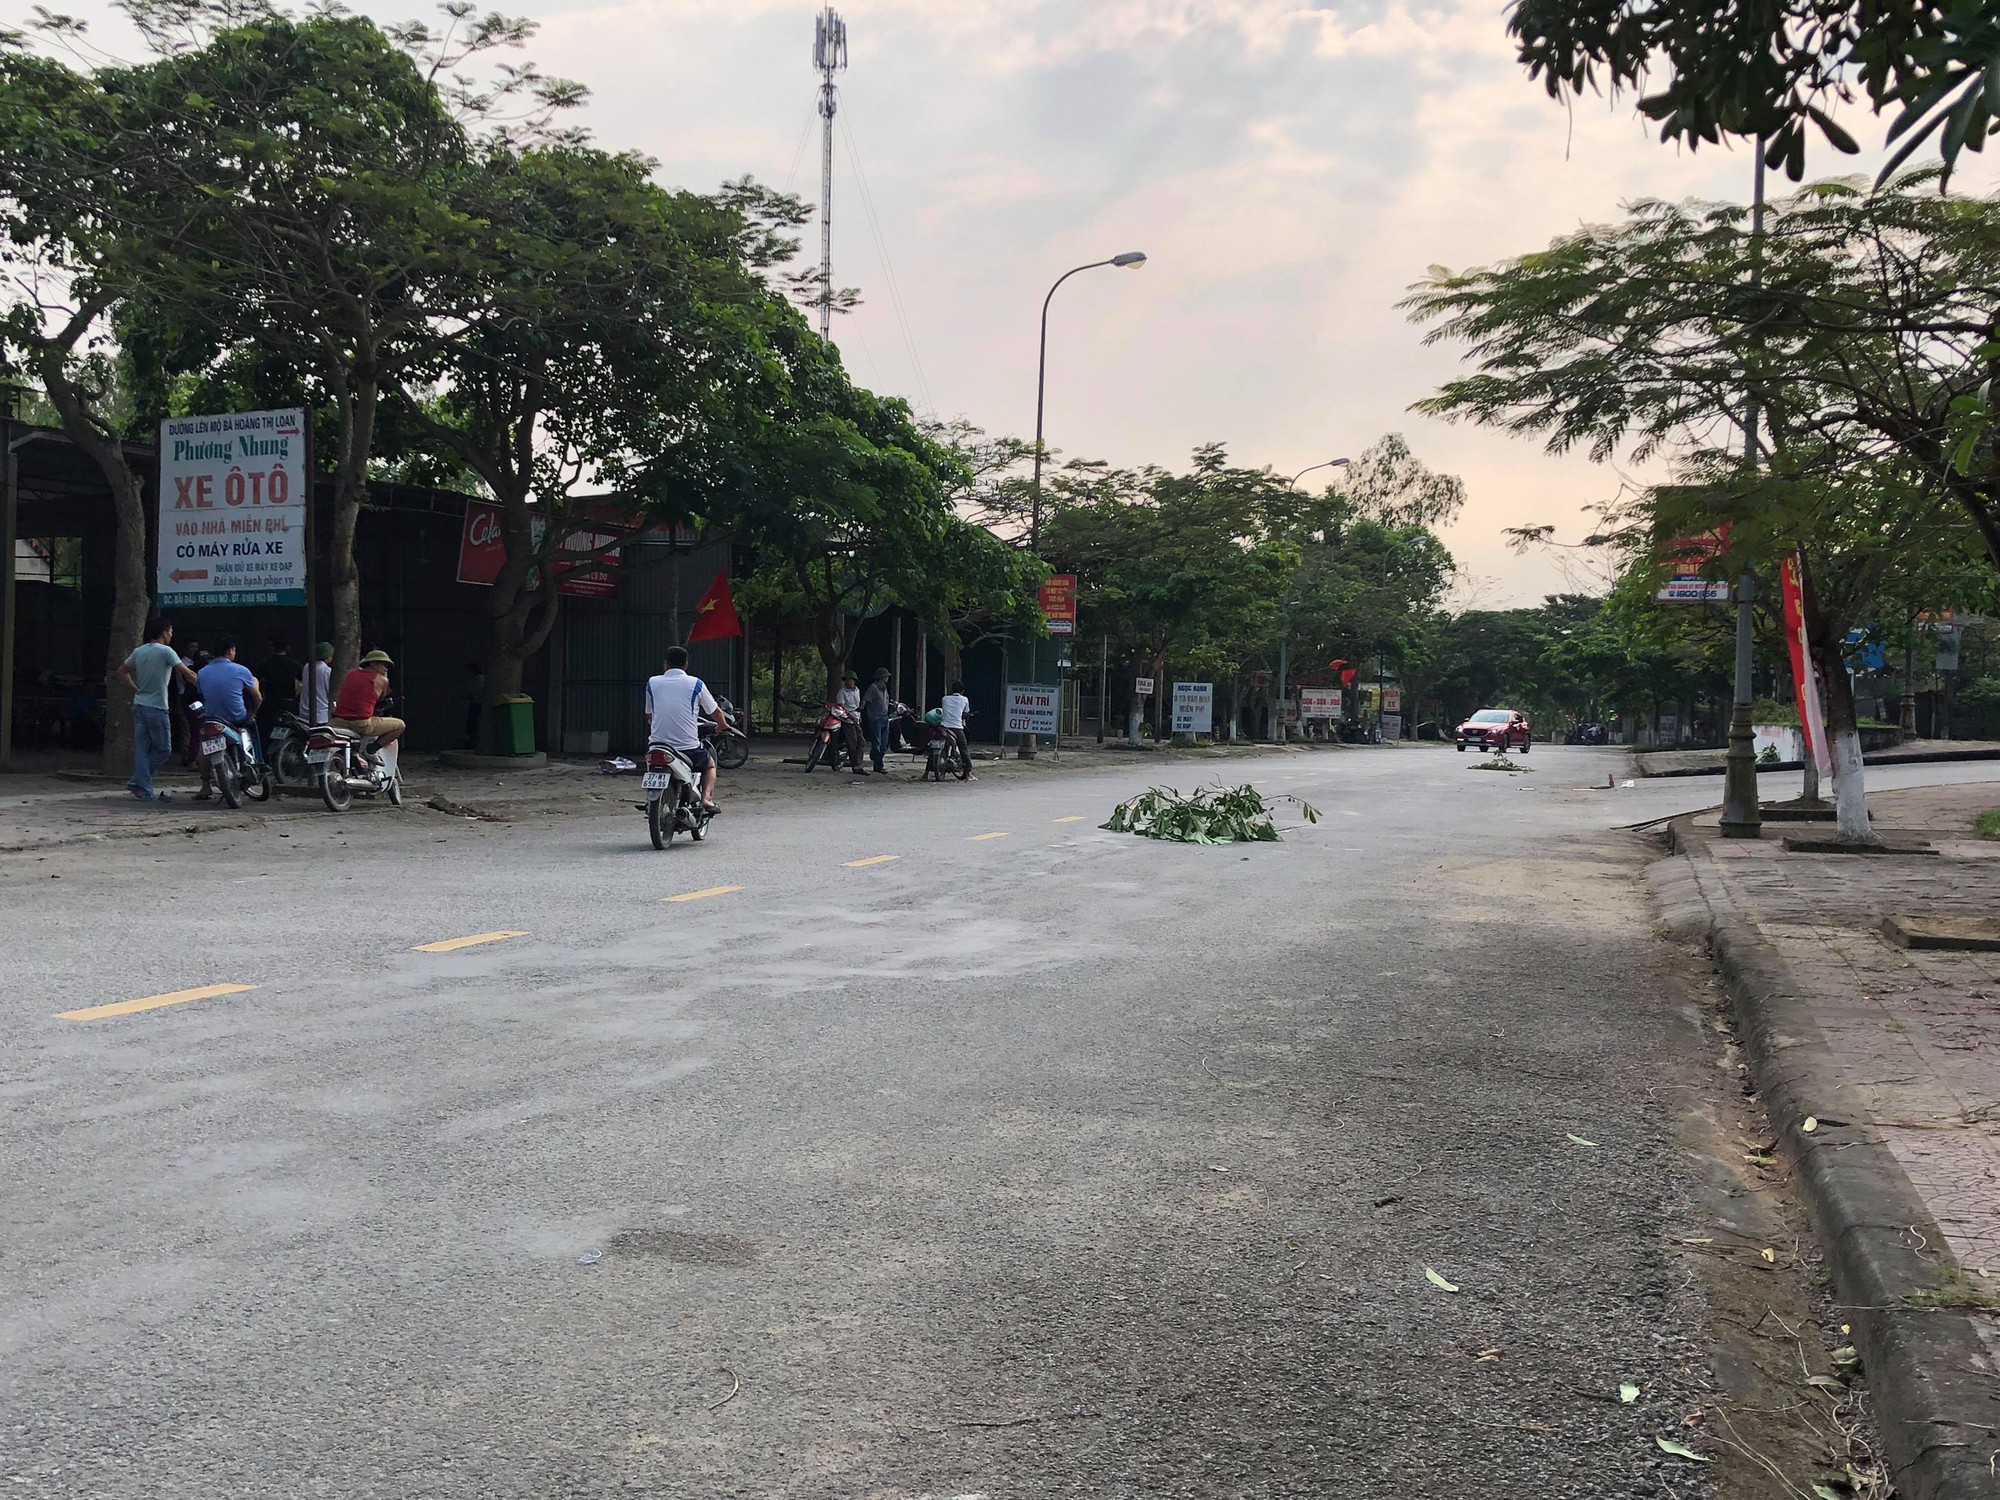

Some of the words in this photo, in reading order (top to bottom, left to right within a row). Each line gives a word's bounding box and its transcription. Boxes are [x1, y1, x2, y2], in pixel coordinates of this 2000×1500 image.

[234, 416, 261, 430] HOÀNG
[275, 414, 295, 427] LOAN
[174, 440, 232, 464] Phương
[238, 435, 289, 460] Nhung
[174, 475, 213, 509] XE
[225, 463, 288, 506] ÔTÔ
[176, 520, 198, 536] VÀO
[202, 518, 226, 534] NHÀ
[176, 541, 195, 558] CÓ
[198, 540, 229, 557] MÁY
[233, 538, 261, 556] RỬA
[265, 542, 283, 554] XE
[246, 563, 254, 571] XE
[270, 562, 278, 571] XE
[1036, 695, 1050, 706] TRÍ
[1010, 717, 1030, 730] GIỮ
